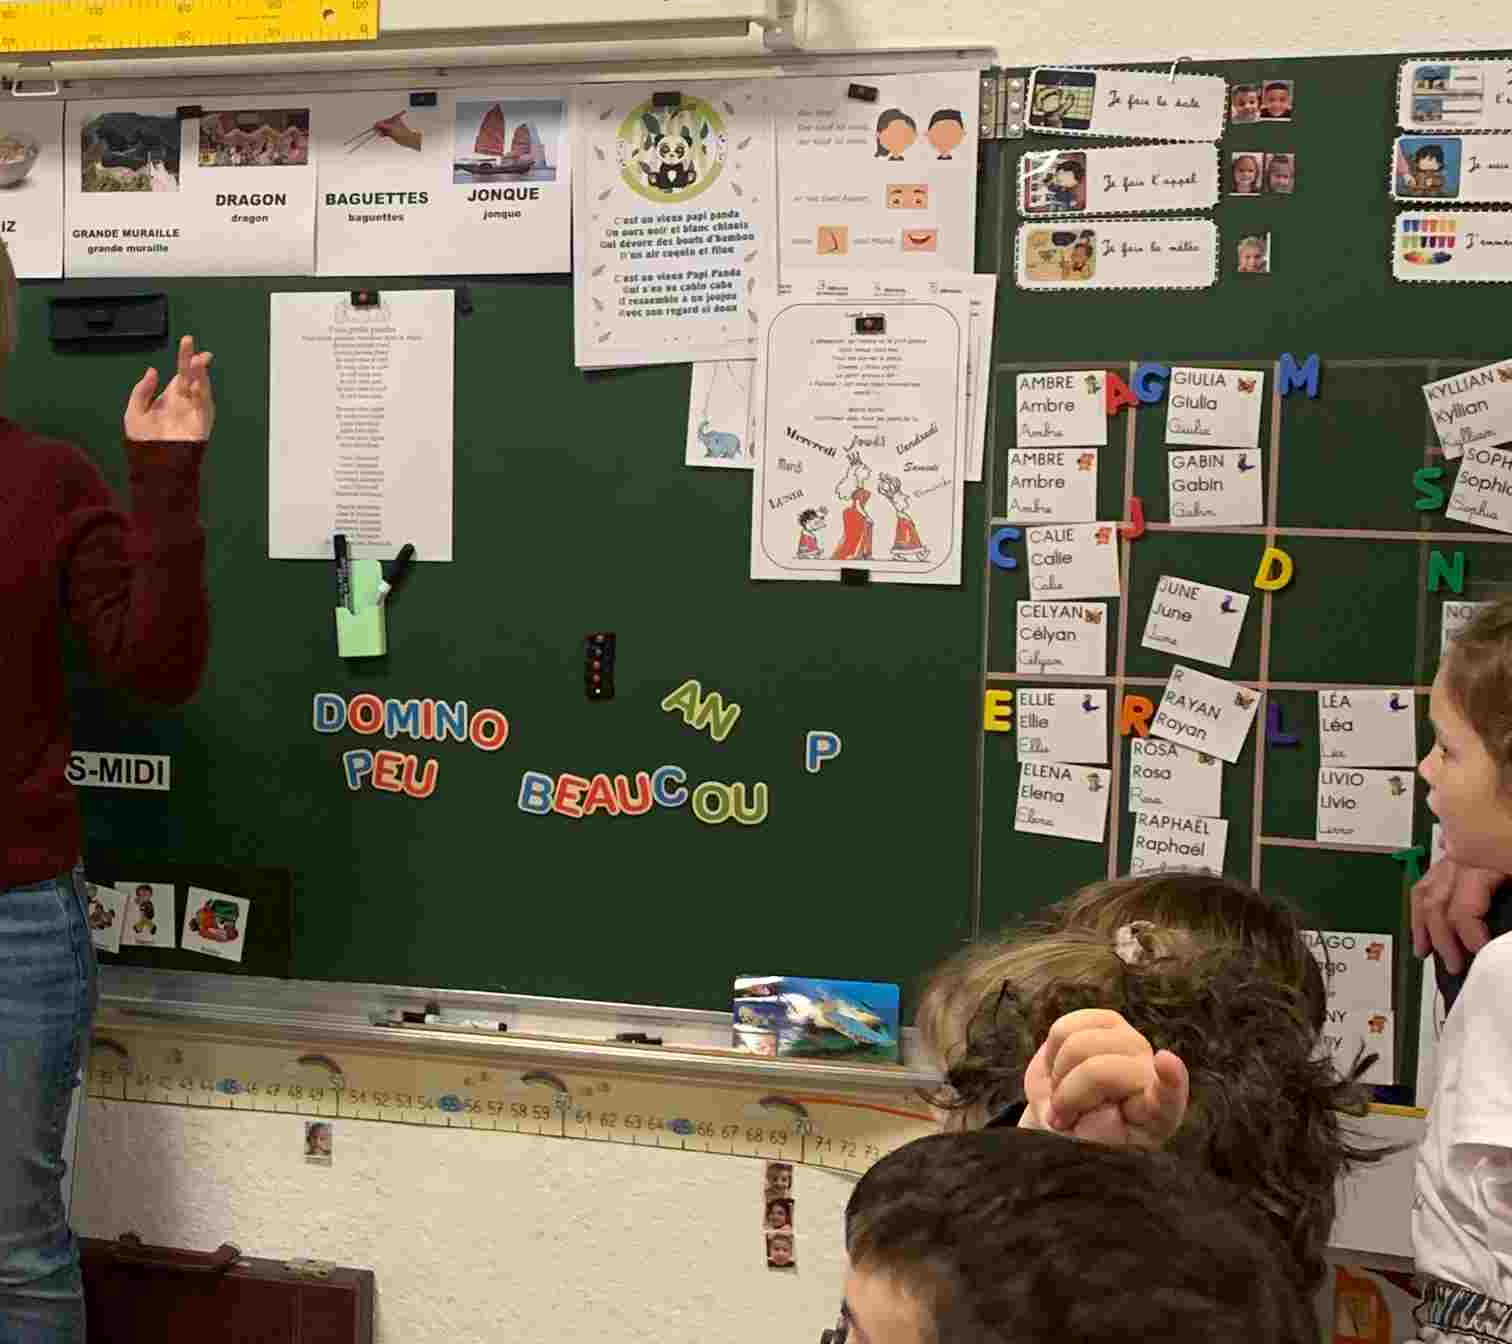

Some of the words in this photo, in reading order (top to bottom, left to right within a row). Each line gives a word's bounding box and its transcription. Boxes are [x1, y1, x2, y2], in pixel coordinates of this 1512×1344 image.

[215, 193, 287, 207] DRAGON
[325, 191, 429, 206] BAGUETTES
[467, 187, 540, 203] JONQUE
[231, 213, 269, 224] dragon
[348, 212, 405, 224] baguettes
[483, 209, 522, 221] jonque
[73, 228, 120, 239] GRANDE
[122, 227, 180, 238] MURAILLE
[87, 244, 125, 255] grande
[127, 242, 169, 253] muraille
[1019, 374, 1074, 390] AMBRE
[1134, 362, 1171, 405] G
[1173, 372, 1227, 388] GIULIA
[1279, 353, 1320, 399] M
[1430, 370, 1495, 400] KYLLIAN
[1106, 372, 1139, 417] A
[1171, 394, 1218, 411] Giulia
[1019, 398, 1076, 414] Ambre
[1435, 398, 1489, 425] Kyllian
[1010, 452, 1065, 466] AMBRE
[1171, 455, 1225, 470] GABIN
[1009, 474, 1066, 489] Ambre
[1171, 477, 1224, 493] Gabin
[1412, 467, 1447, 512] S
[1120, 496, 1145, 541] J
[1029, 528, 1074, 543] CALIE
[988, 527, 1022, 569] C
[1030, 551, 1073, 567] Calie
[1254, 547, 1294, 592] D
[1426, 550, 1465, 593] N
[1159, 582, 1201, 601] JUNE
[1151, 598, 1193, 623] June
[1172, 670, 1184, 683] R
[1019, 692, 1056, 706] ELLIE
[1163, 690, 1223, 721] RAYAN
[1322, 691, 1352, 710] LÉA
[662, 679, 740, 741] AN
[984, 689, 1014, 733] E
[1120, 695, 1155, 737] R
[313, 692, 509, 750] DOMINO
[1019, 714, 1049, 729] Ellie
[1155, 712, 1208, 742] Rayan
[1265, 704, 1299, 745] L
[1321, 715, 1354, 734] Léa
[805, 729, 842, 773] P
[1133, 742, 1179, 758] ROSA
[343, 748, 439, 798] PEU
[1023, 763, 1072, 782] ELENA
[1132, 764, 1172, 781] Rosa
[1321, 772, 1365, 787] LIVIO
[1020, 784, 1065, 803] Elena
[510, 1104, 528, 1118] 58
[533, 1105, 550, 1120] 59
[697, 1122, 714, 1137] 66
[721, 1124, 739, 1139] 67
[746, 1127, 763, 1143] 68
[769, 1129, 787, 1145] 69
